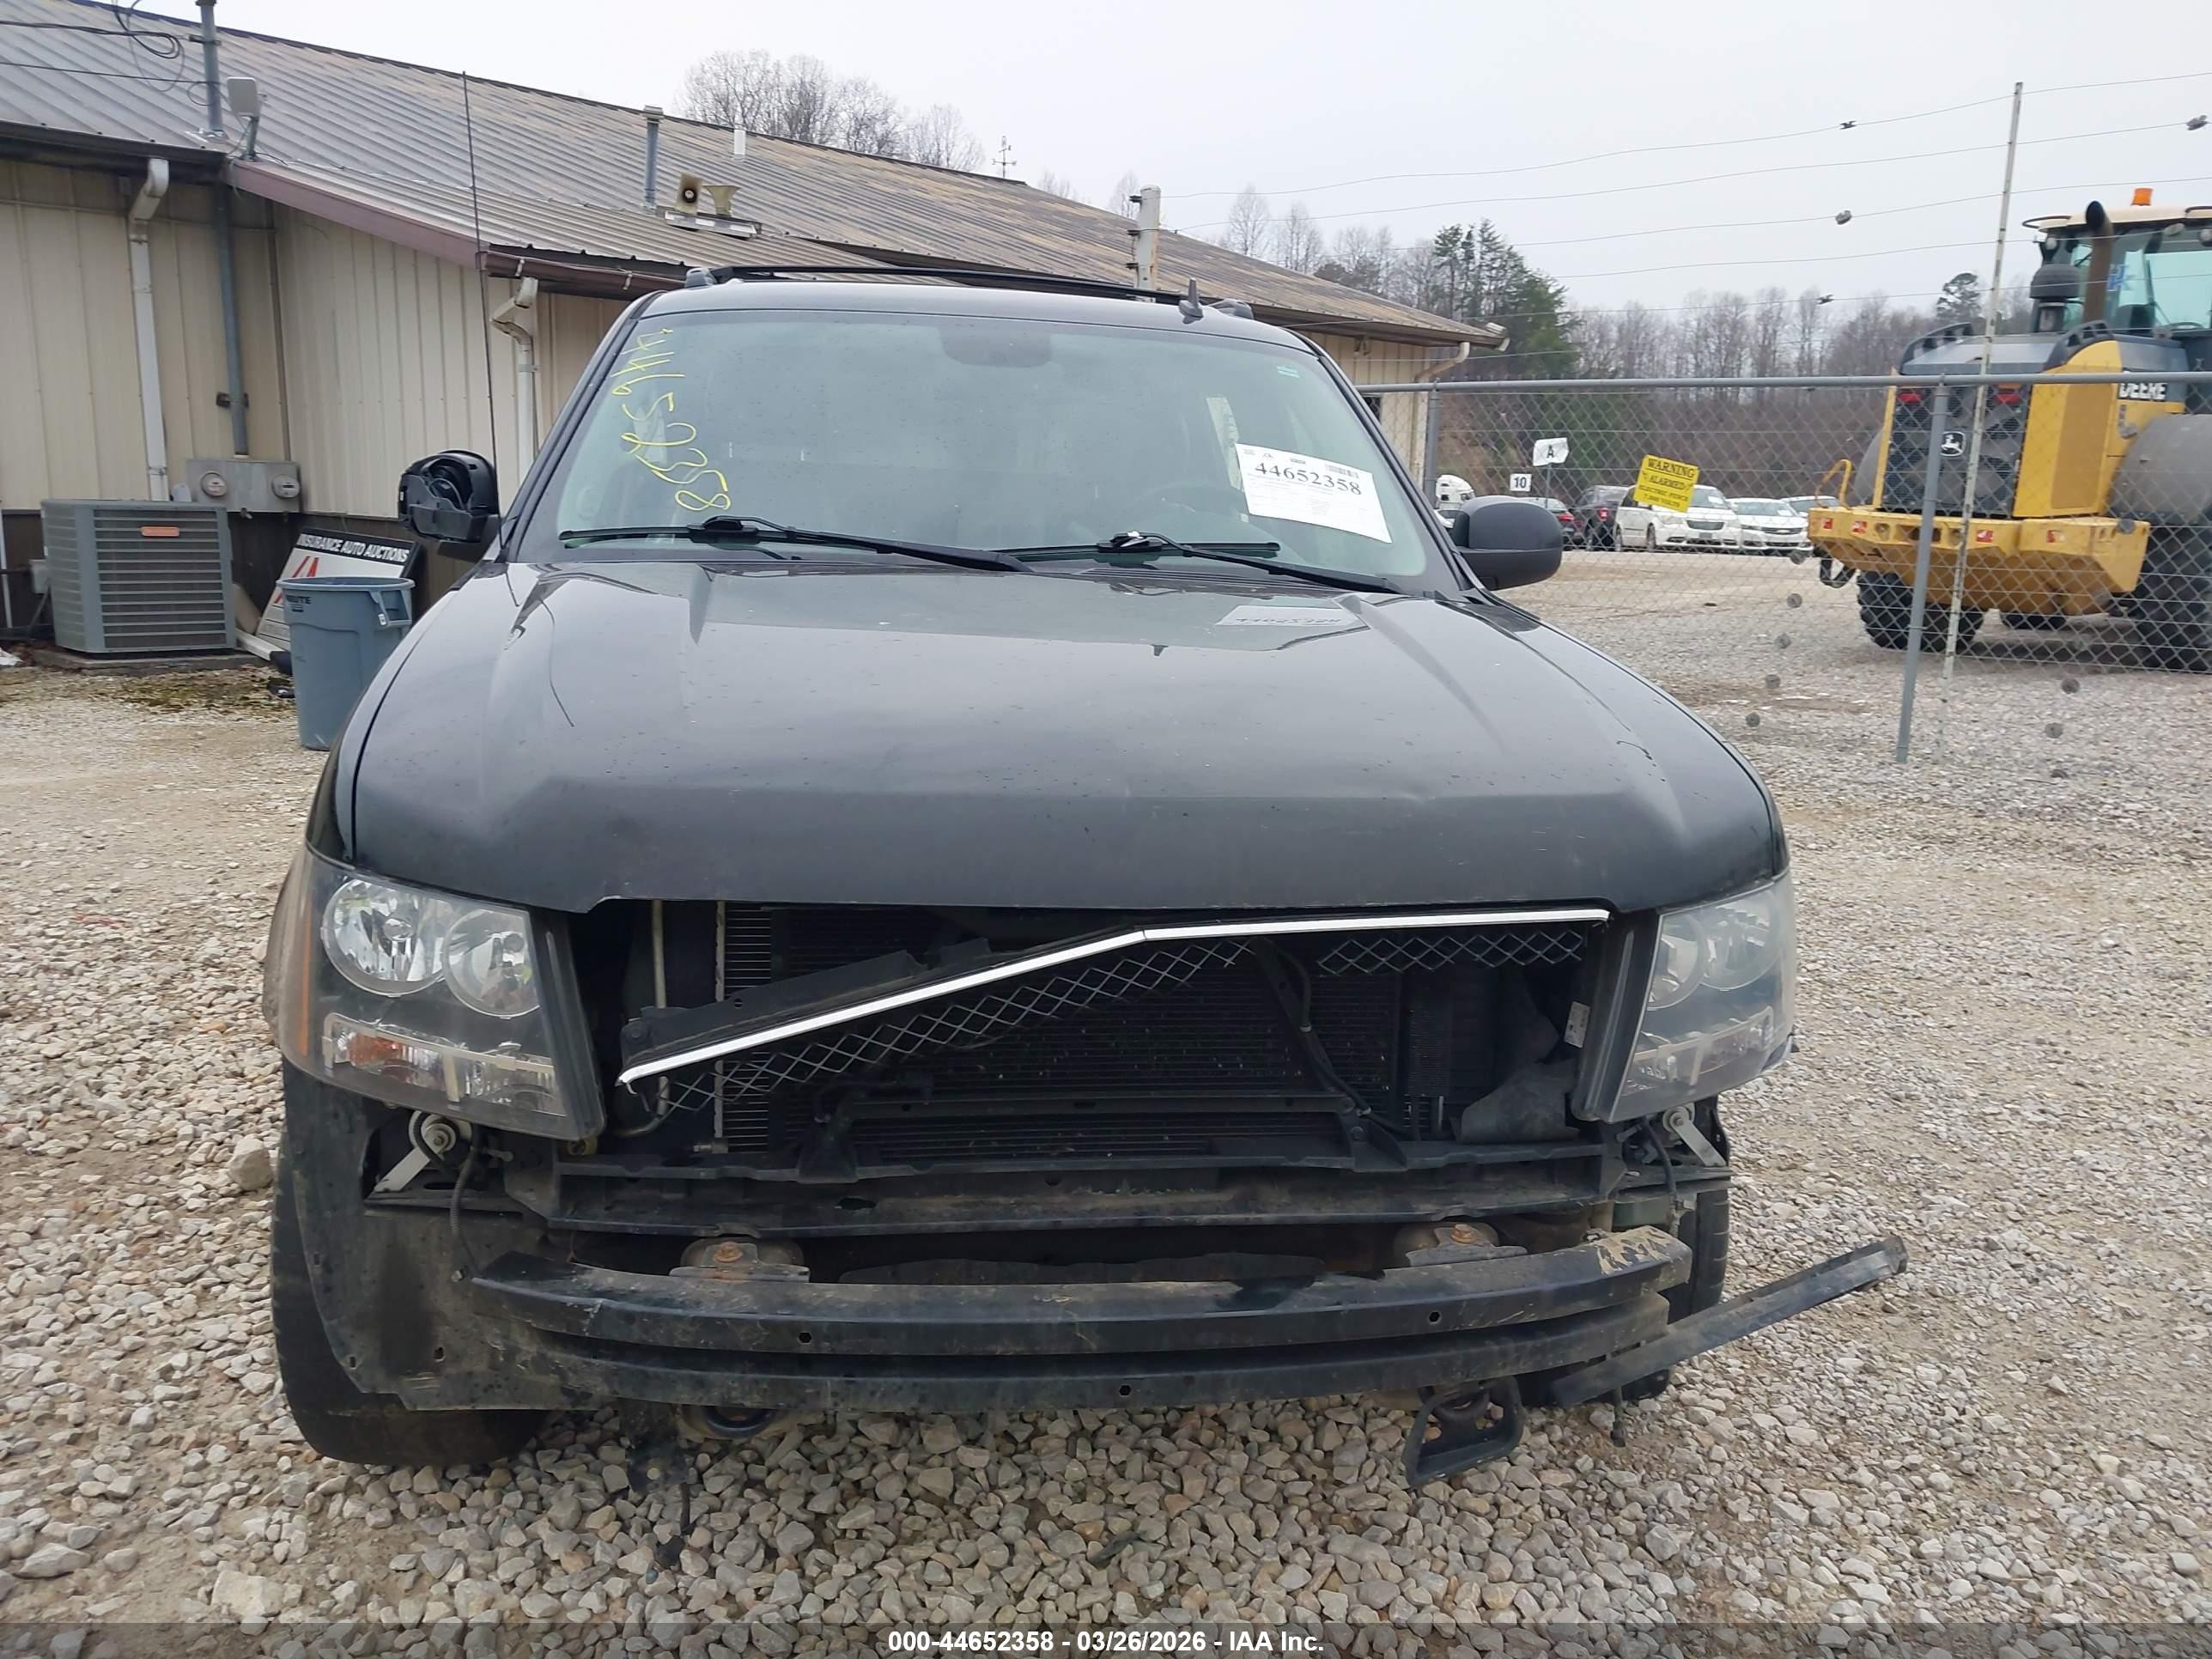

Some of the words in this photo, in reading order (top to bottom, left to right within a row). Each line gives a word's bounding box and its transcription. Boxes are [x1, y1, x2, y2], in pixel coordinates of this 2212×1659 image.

[1547, 444, 1555, 459] A
[1648, 458, 1696, 478] WARNING
[1255, 462, 1363, 495] 44652358
[1514, 477, 1527, 489] 10
[1648, 475, 1687, 490] ALARMED
[296, 532, 342, 552] INSURANCE
[342, 540, 366, 556] AUTO
[363, 544, 410, 562] AUCTIONS
